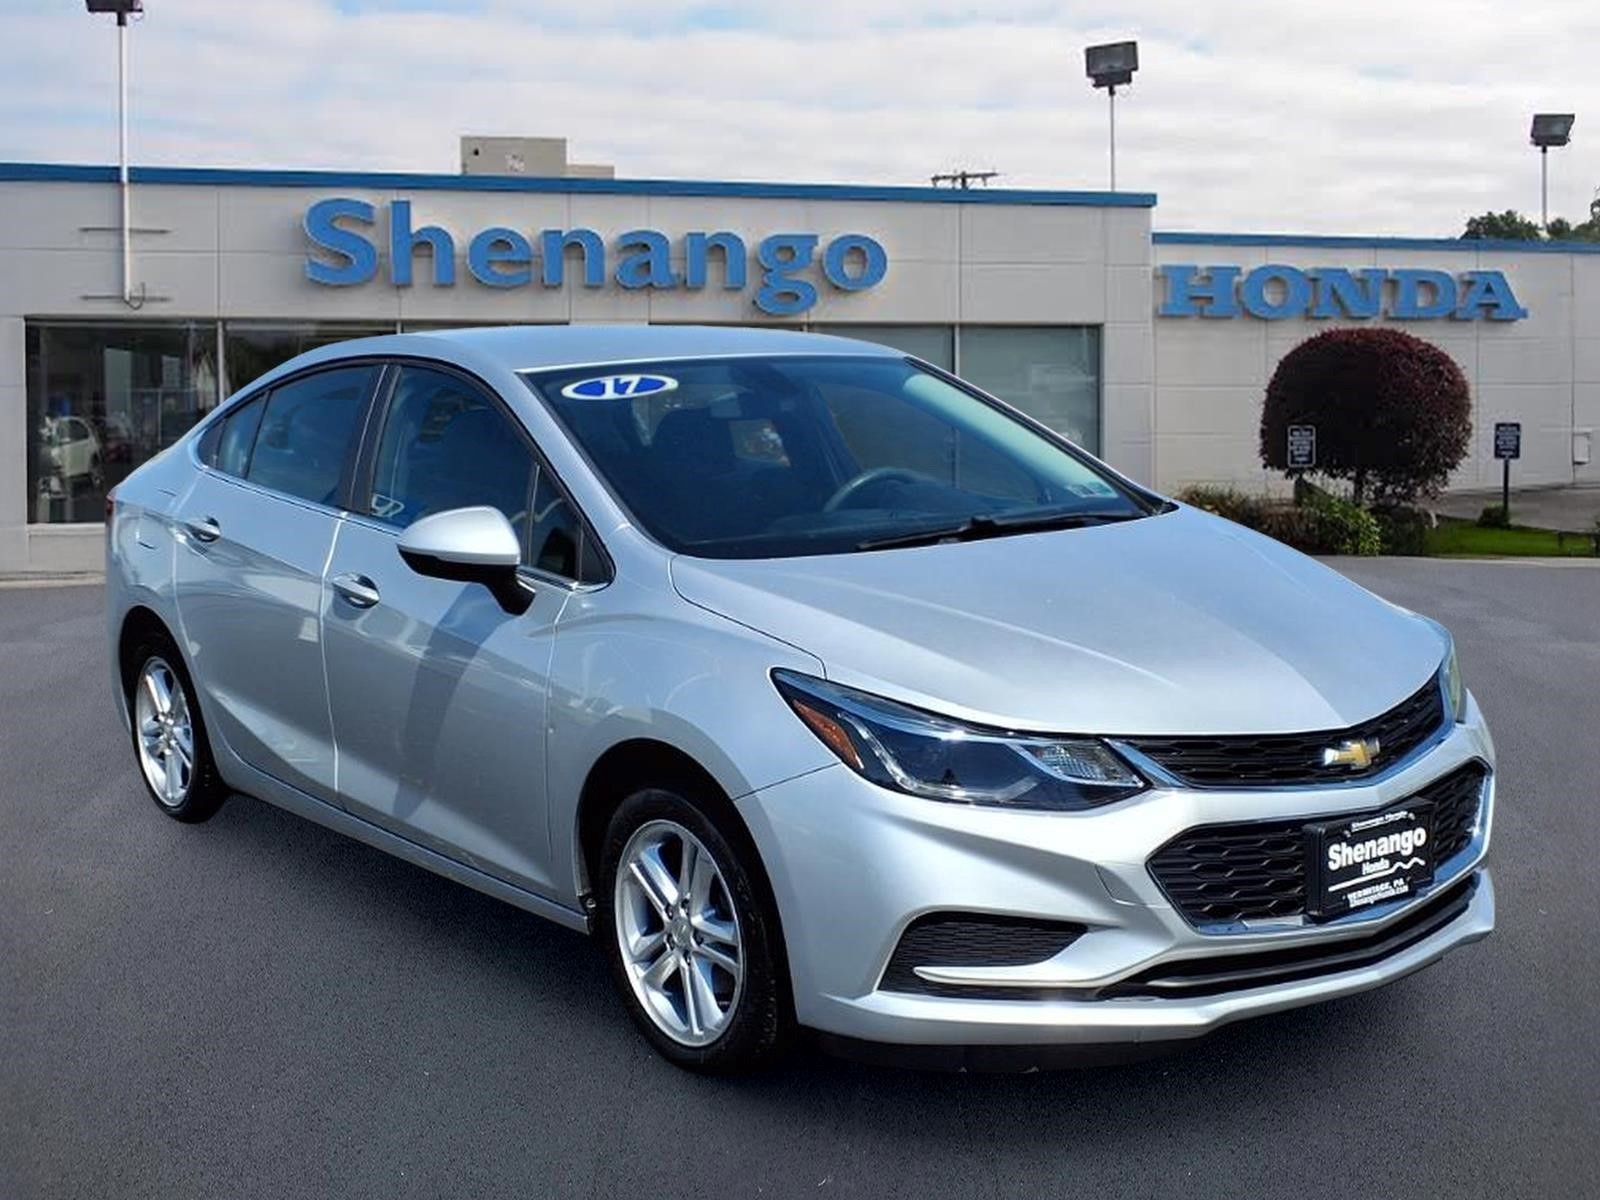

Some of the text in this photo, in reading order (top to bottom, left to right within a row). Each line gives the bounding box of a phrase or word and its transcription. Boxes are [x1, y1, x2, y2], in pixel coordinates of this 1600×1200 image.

[303, 197, 888, 315] Shenango
[1158, 264, 1528, 320] HONDA
[600, 375, 641, 398] 17
[1328, 827, 1426, 870] Shenango
[1362, 857, 1390, 875] Honda
